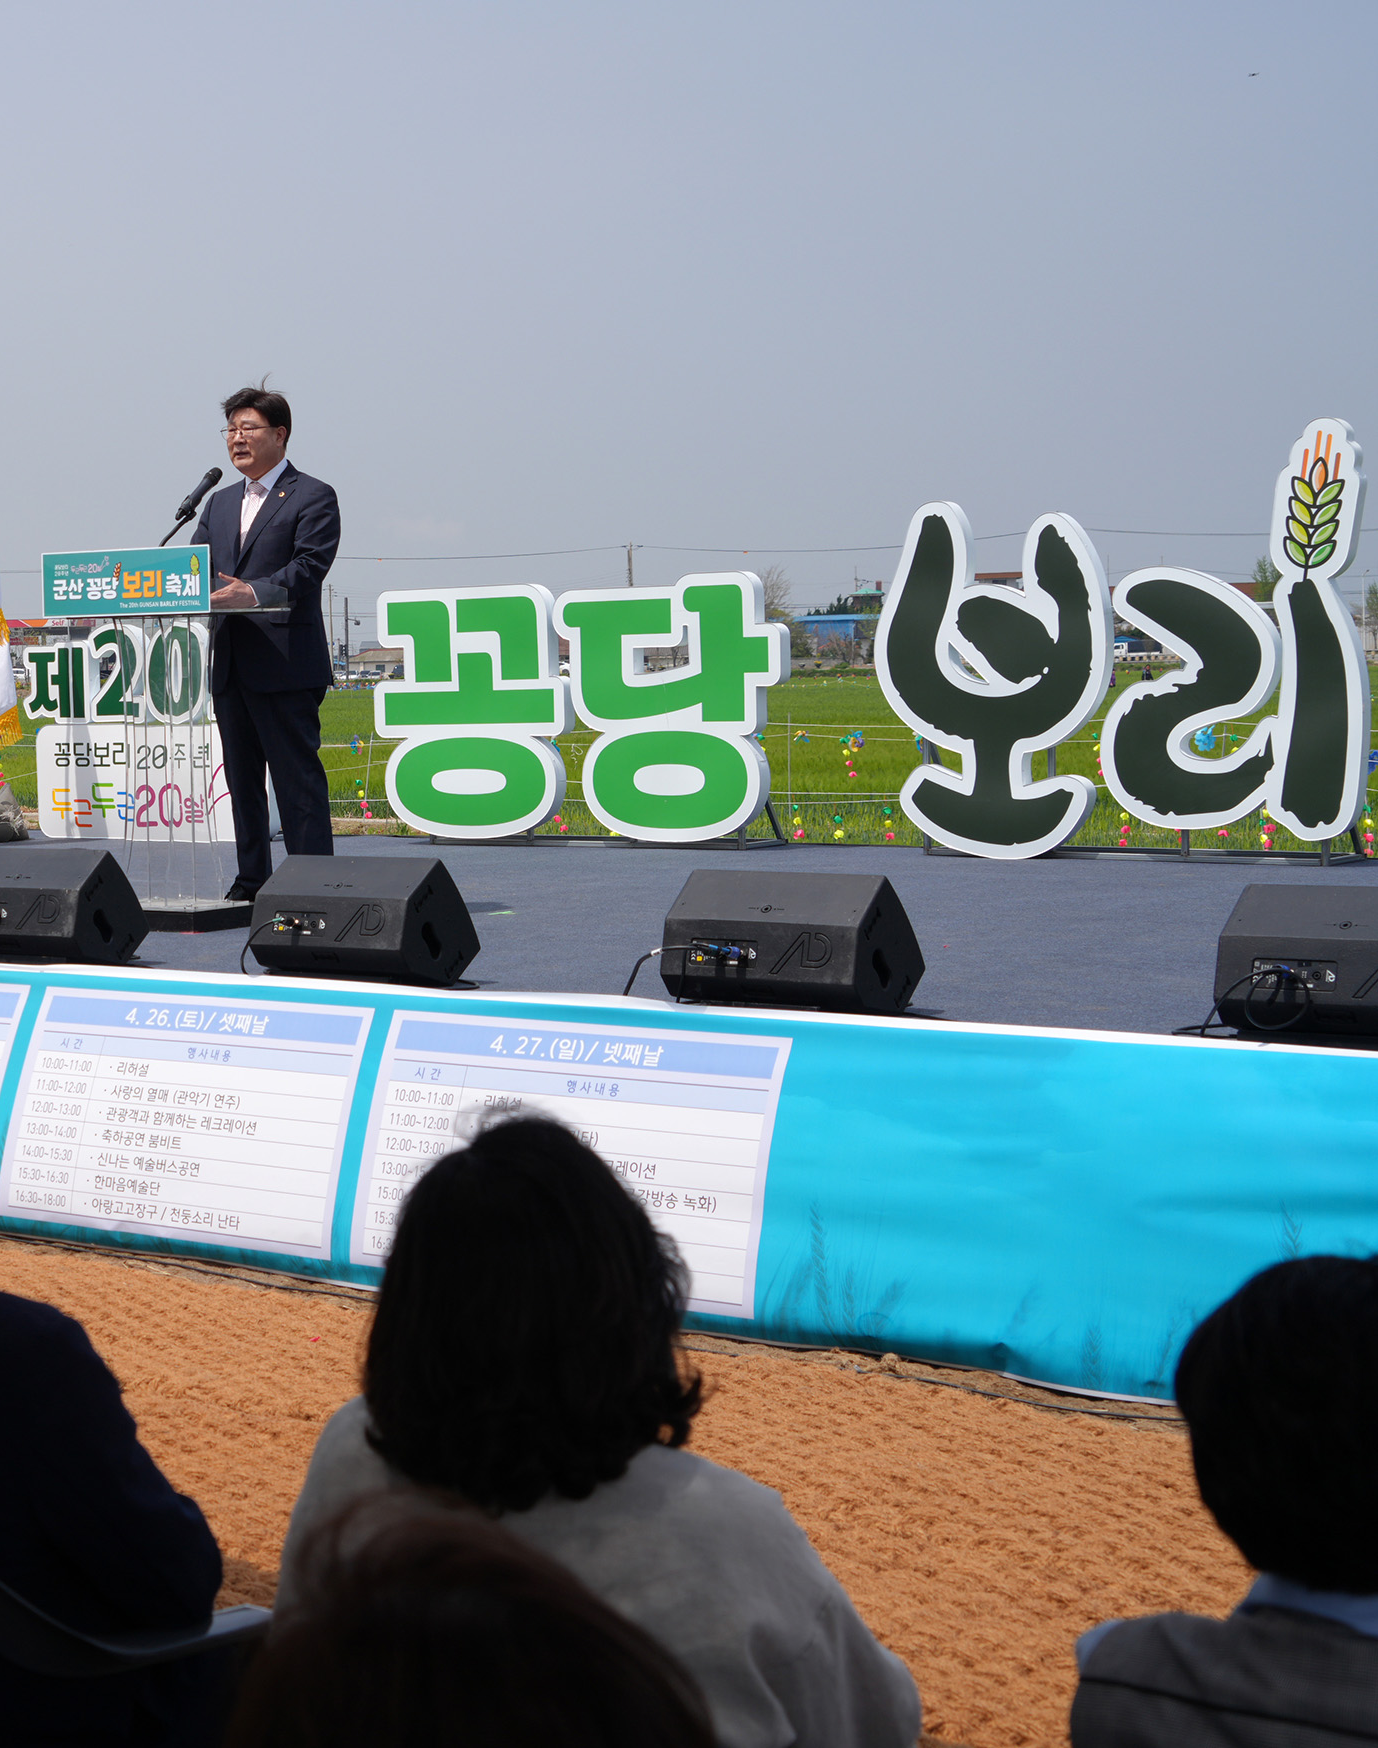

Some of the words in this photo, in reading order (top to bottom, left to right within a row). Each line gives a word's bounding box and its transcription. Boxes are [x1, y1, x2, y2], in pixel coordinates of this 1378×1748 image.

[53, 578, 84, 600] 군산
[87, 577, 119, 600] 꽁당
[122, 570, 165, 598] 보리
[165, 573, 200, 596] 축제
[384, 584, 769, 829] 꽁당
[886, 513, 1348, 845] 보리
[54, 743, 130, 768] 꽁당보리
[125, 1008, 139, 1025] 4.
[219, 1012, 269, 1035] 셋째날
[490, 1035, 508, 1054] 4.
[602, 1041, 664, 1067] 넷째날
[42, 1057, 93, 1072] 10:00~11:00
[116, 1062, 150, 1077] 리허설
[36, 1079, 87, 1094] 11:00~12:00
[110, 1085, 144, 1102] 사랑의
[147, 1088, 169, 1103] 열매
[172, 1089, 210, 1107] (관악기
[213, 1093, 241, 1110] 연주)
[393, 1088, 454, 1106] 10:00~11:00
[31, 1101, 81, 1116] 12:00~13:00
[26, 1122, 77, 1139] 13:00~14:00
[106, 1107, 150, 1124] 관광객과
[153, 1110, 198, 1130] 함께하는
[200, 1116, 257, 1136] 레크레이션
[389, 1113, 450, 1131] 11:00~12:00
[102, 1128, 145, 1148] 축하공연
[148, 1132, 181, 1150] 붐비트
[385, 1137, 445, 1156] 12:00~13:00
[22, 1145, 73, 1161] 14:00~15:30
[97, 1152, 130, 1169] 신나는
[133, 1156, 200, 1177] 예술버스공연
[18, 1167, 69, 1184] 15:30~16:30
[94, 1175, 160, 1196] 한마음예술단
[15, 1190, 67, 1207] 16:30~18:00
[683, 1194, 717, 1213] 녹화)
[91, 1198, 158, 1220] 아랑고고장구
[170, 1208, 214, 1227] 천둥소리
[217, 1213, 240, 1231] 난타
